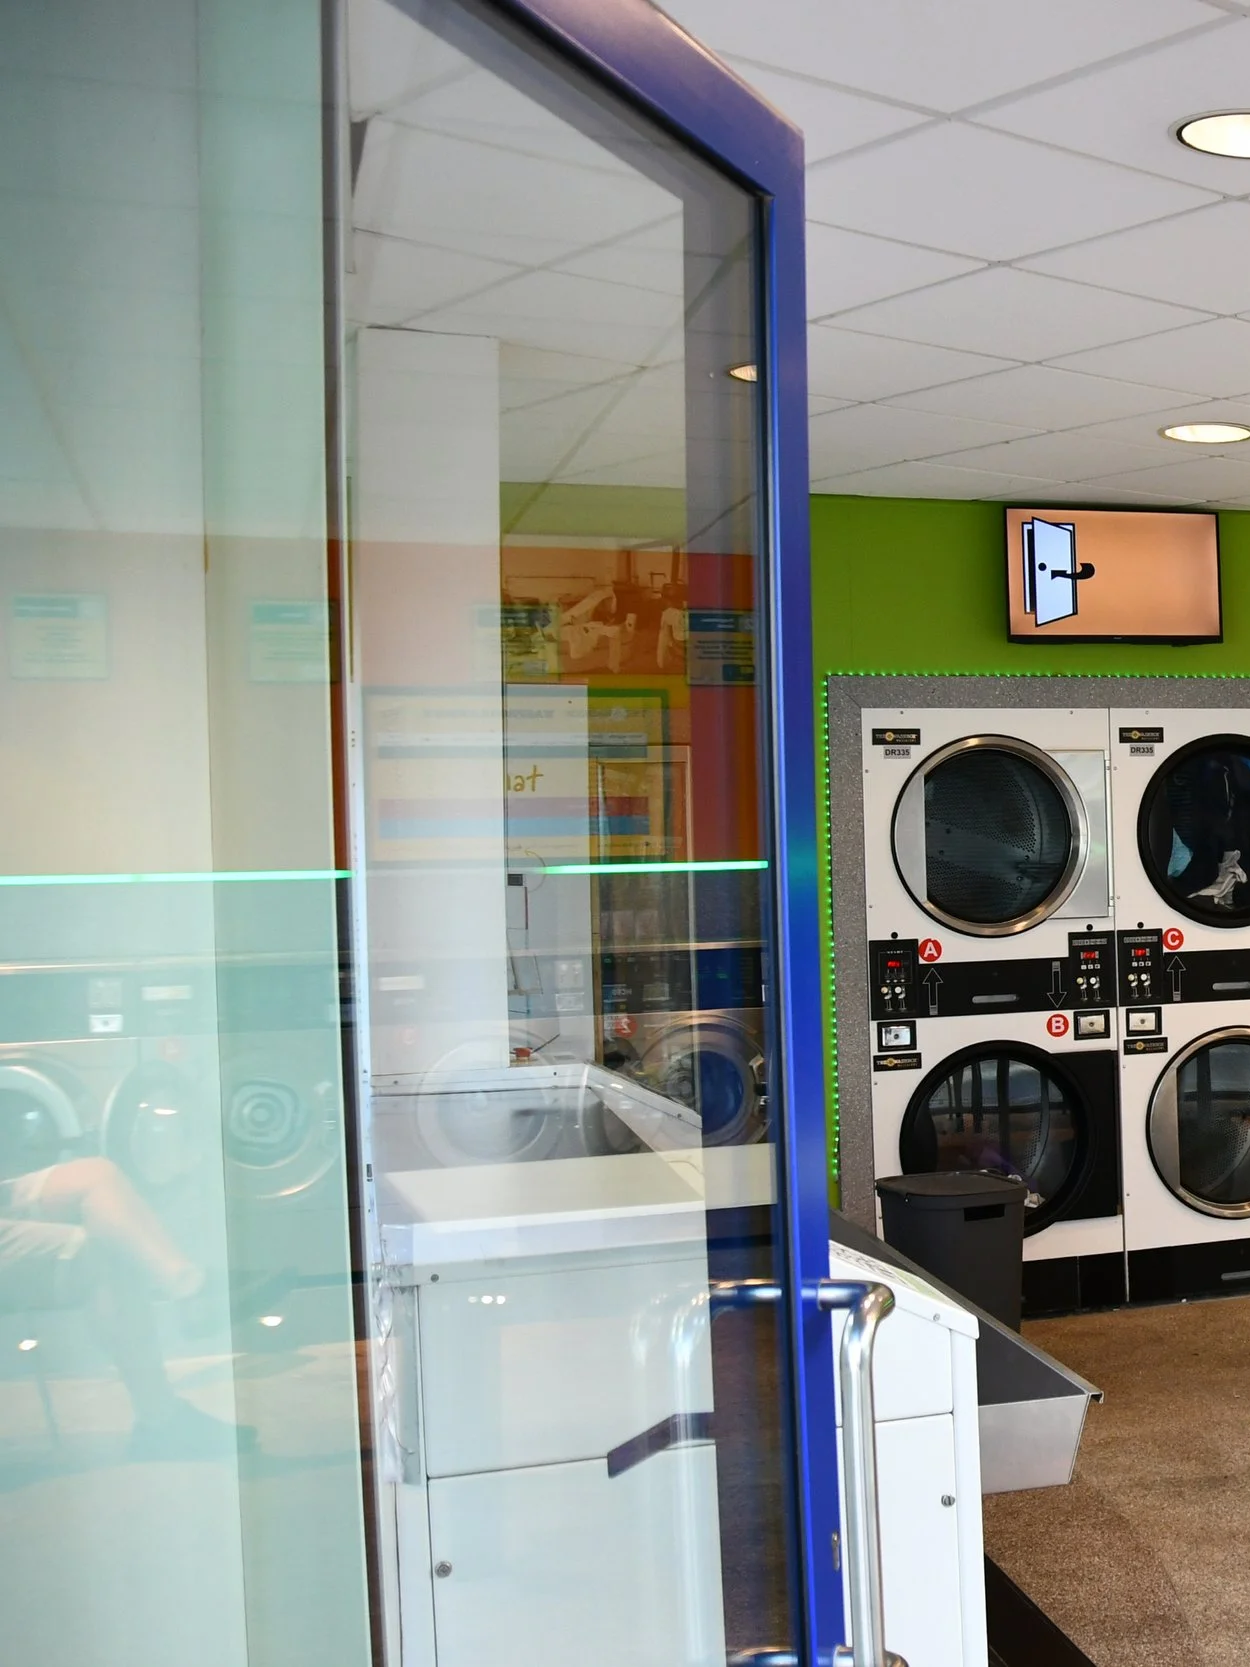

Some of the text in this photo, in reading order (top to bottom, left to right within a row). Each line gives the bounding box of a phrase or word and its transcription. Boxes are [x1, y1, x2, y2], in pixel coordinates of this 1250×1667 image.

[1167, 930, 1180, 946] C
[923, 942, 938, 958] A
[1051, 1016, 1065, 1033] B
